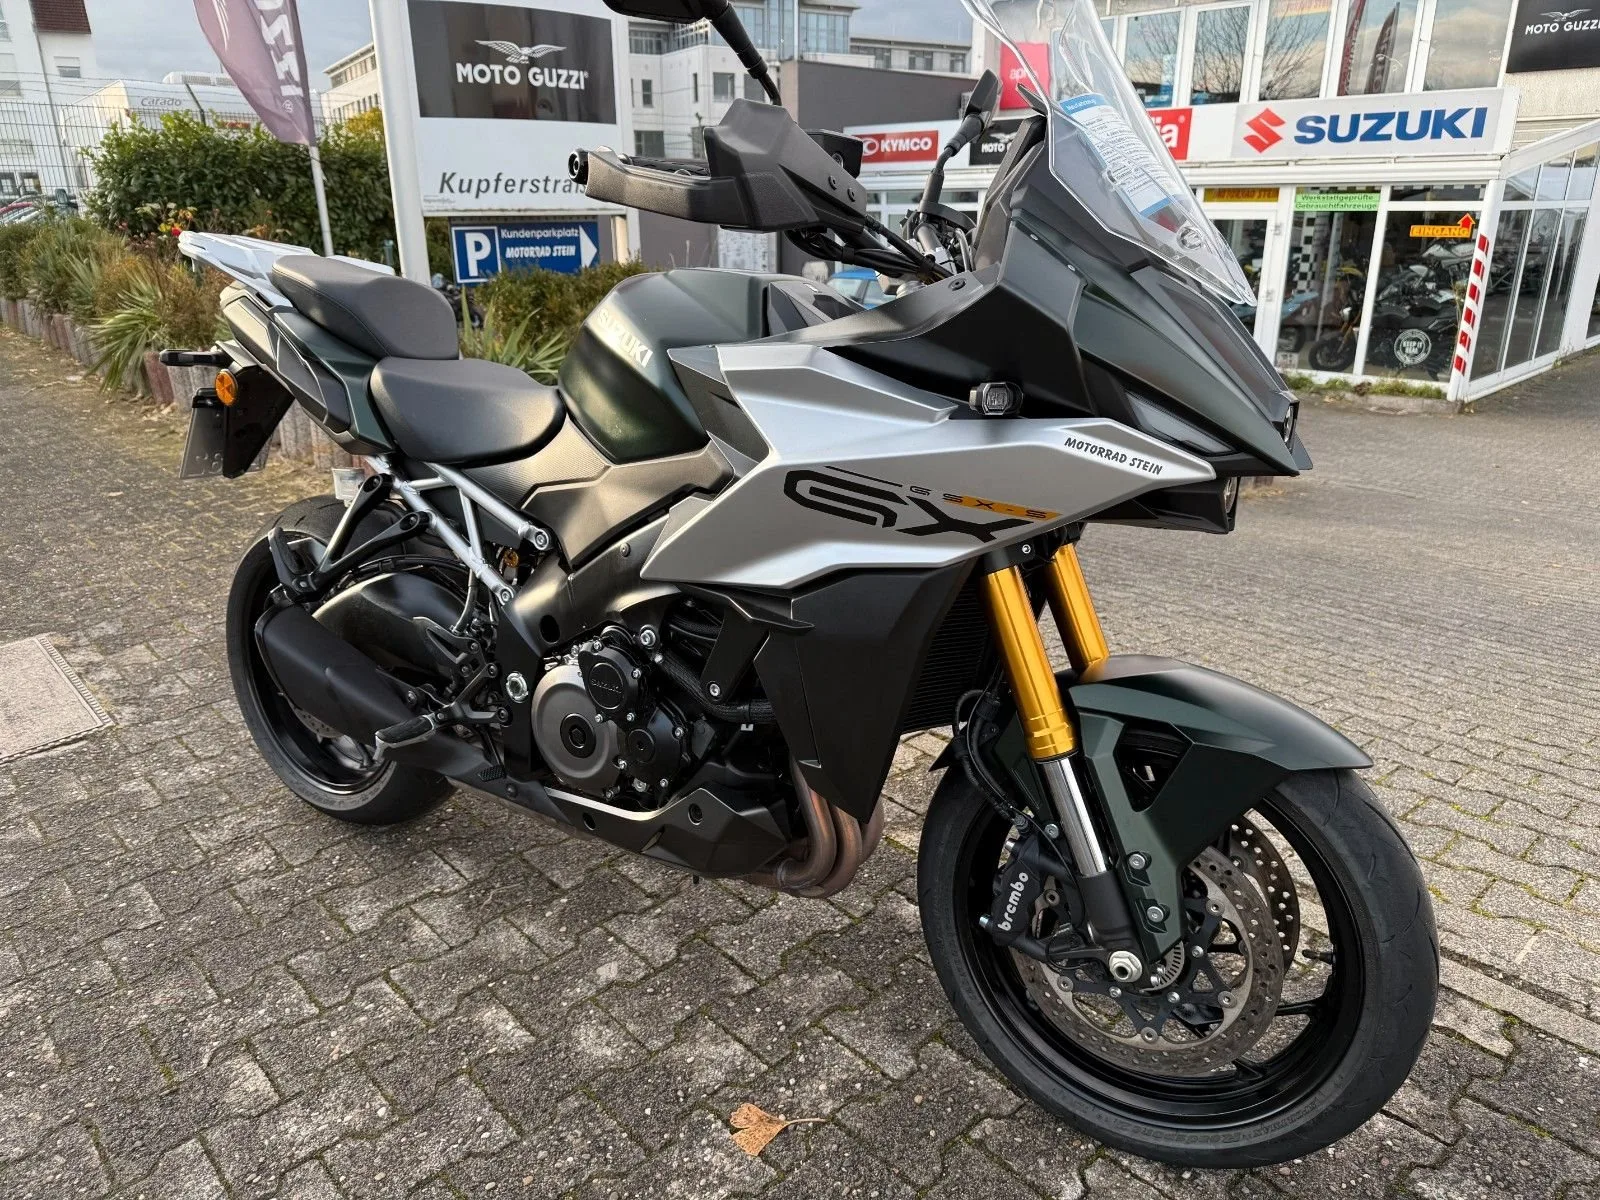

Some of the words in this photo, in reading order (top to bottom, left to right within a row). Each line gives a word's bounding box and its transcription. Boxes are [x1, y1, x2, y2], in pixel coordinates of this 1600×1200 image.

[1525, 23, 1559, 35] MOTO
[455, 62, 521, 86] MOTO
[140, 96, 182, 107] Carado
[1294, 106, 1488, 145] SUZUKI
[880, 137, 932, 152] KYMCO
[981, 142, 1005, 153] MOTO
[500, 227, 580, 240] Kundenparkplatz
[1411, 227, 1468, 237] EINGANG
[465, 232, 492, 277] P
[505, 246, 552, 259] MOTORRAD
[552, 245, 576, 257] STEIN
[1064, 437, 1128, 464] MOTORRAD
[1129, 457, 1163, 476] STEIN
[997, 872, 1029, 931] brembo
